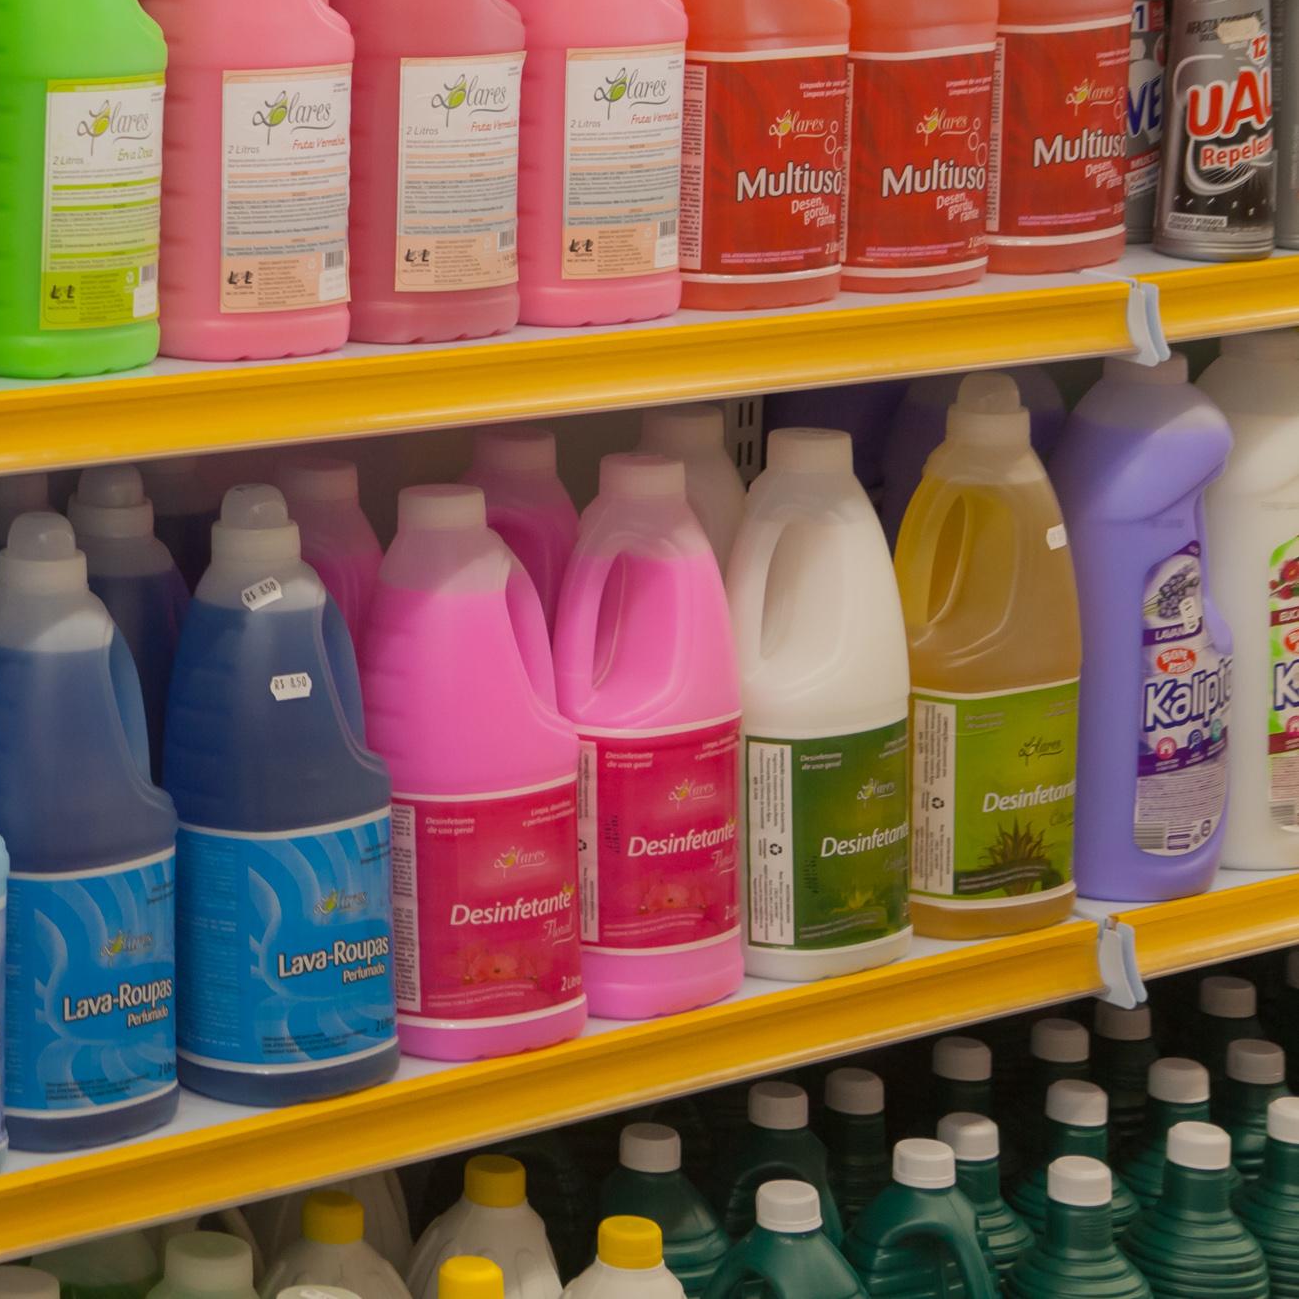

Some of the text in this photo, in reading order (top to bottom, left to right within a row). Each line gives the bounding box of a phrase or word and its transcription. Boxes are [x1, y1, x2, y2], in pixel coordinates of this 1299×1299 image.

[415, 126, 439, 136] Litros
[577, 118, 601, 129] Litros
[60, 155, 85, 166] Litros
[235, 145, 261, 155] Litros
[737, 159, 843, 203] Multiuso
[881, 158, 988, 199] Multiuso
[273, 678, 285, 691] R$
[627, 820, 737, 858] Desinfetante
[450, 889, 573, 927] Desinfetante
[277, 934, 390, 979] Lava-Roupas
[342, 963, 386, 984] Perfumado
[62, 977, 173, 1022] Lava-Roupas
[126, 1004, 169, 1028] Perfumado
